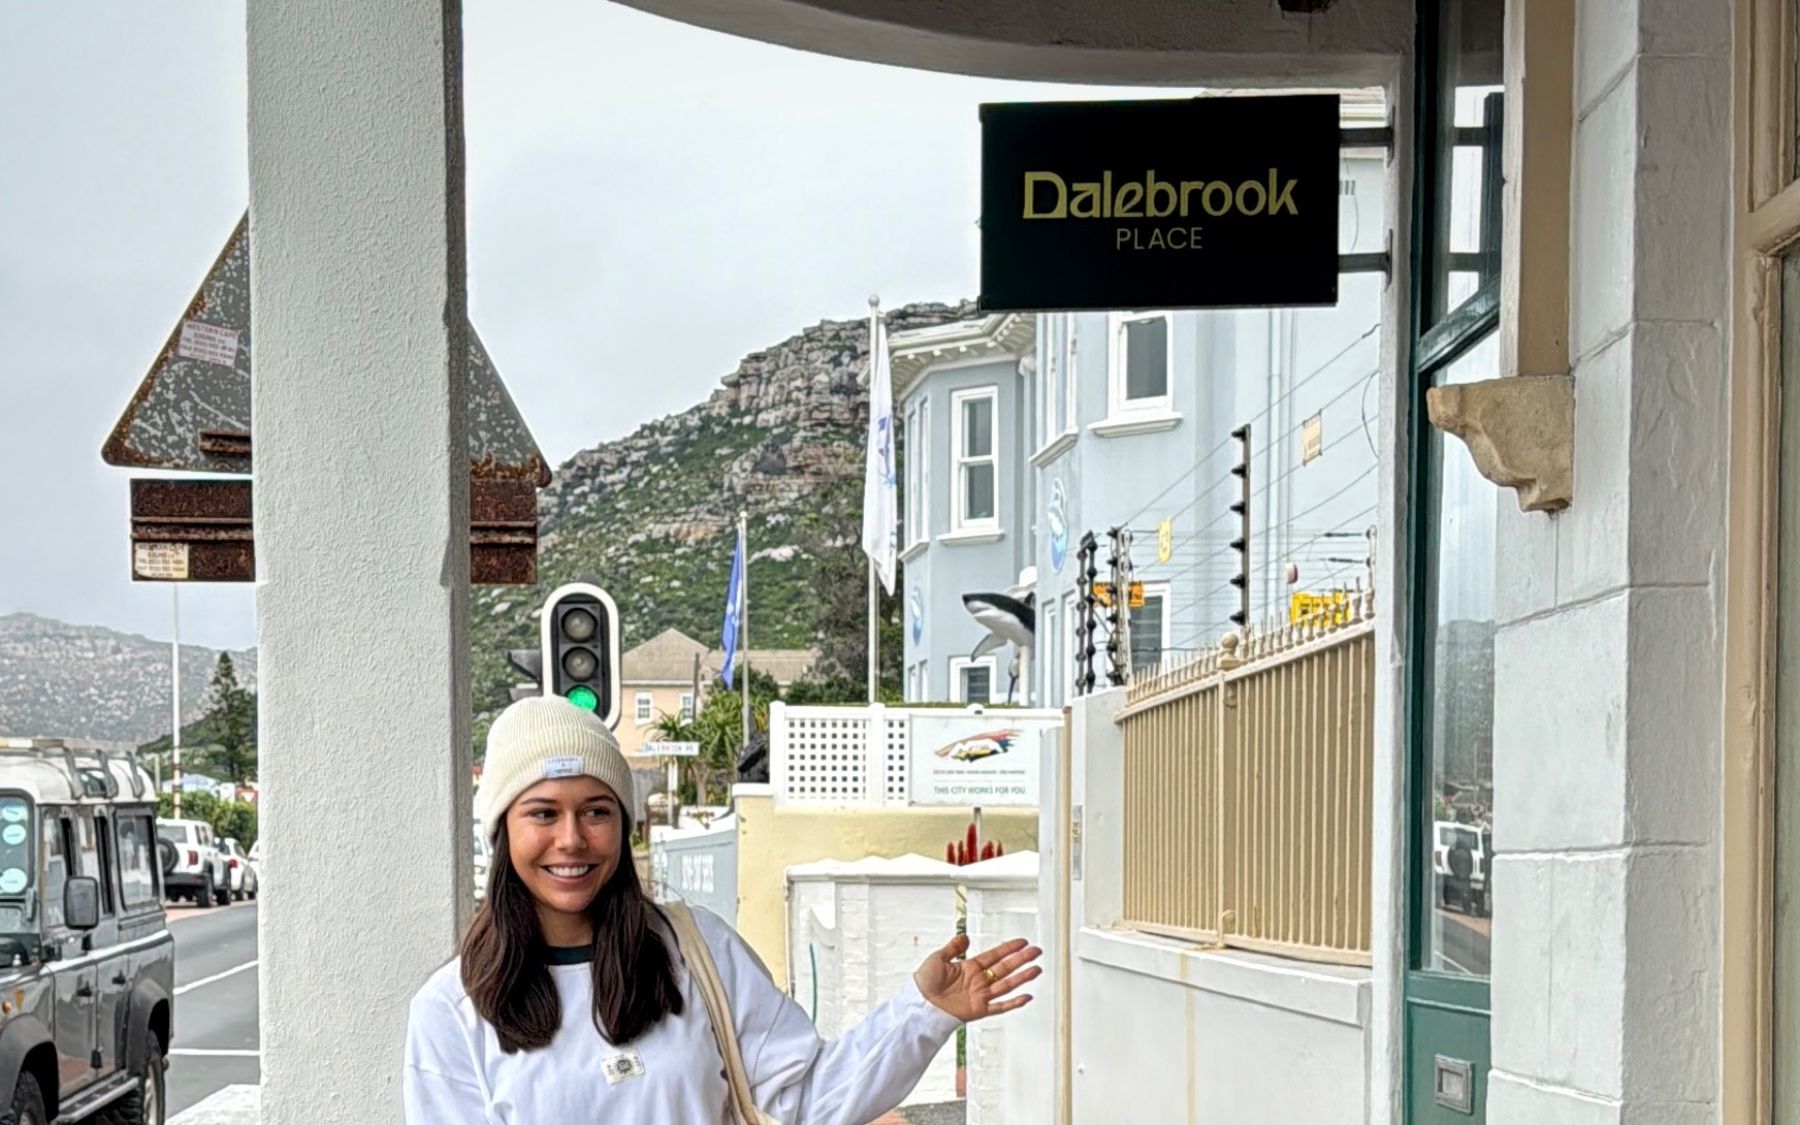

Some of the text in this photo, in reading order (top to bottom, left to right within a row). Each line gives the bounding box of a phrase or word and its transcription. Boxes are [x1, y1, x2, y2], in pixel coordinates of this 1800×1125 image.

[1022, 168, 1299, 219] Dalebrook
[1116, 227, 1203, 250] PLACE
[950, 786, 966, 795] CITY
[967, 786, 993, 795] WORKS
[995, 786, 1009, 795] FOR
[1010, 786, 1026, 795] YOU
